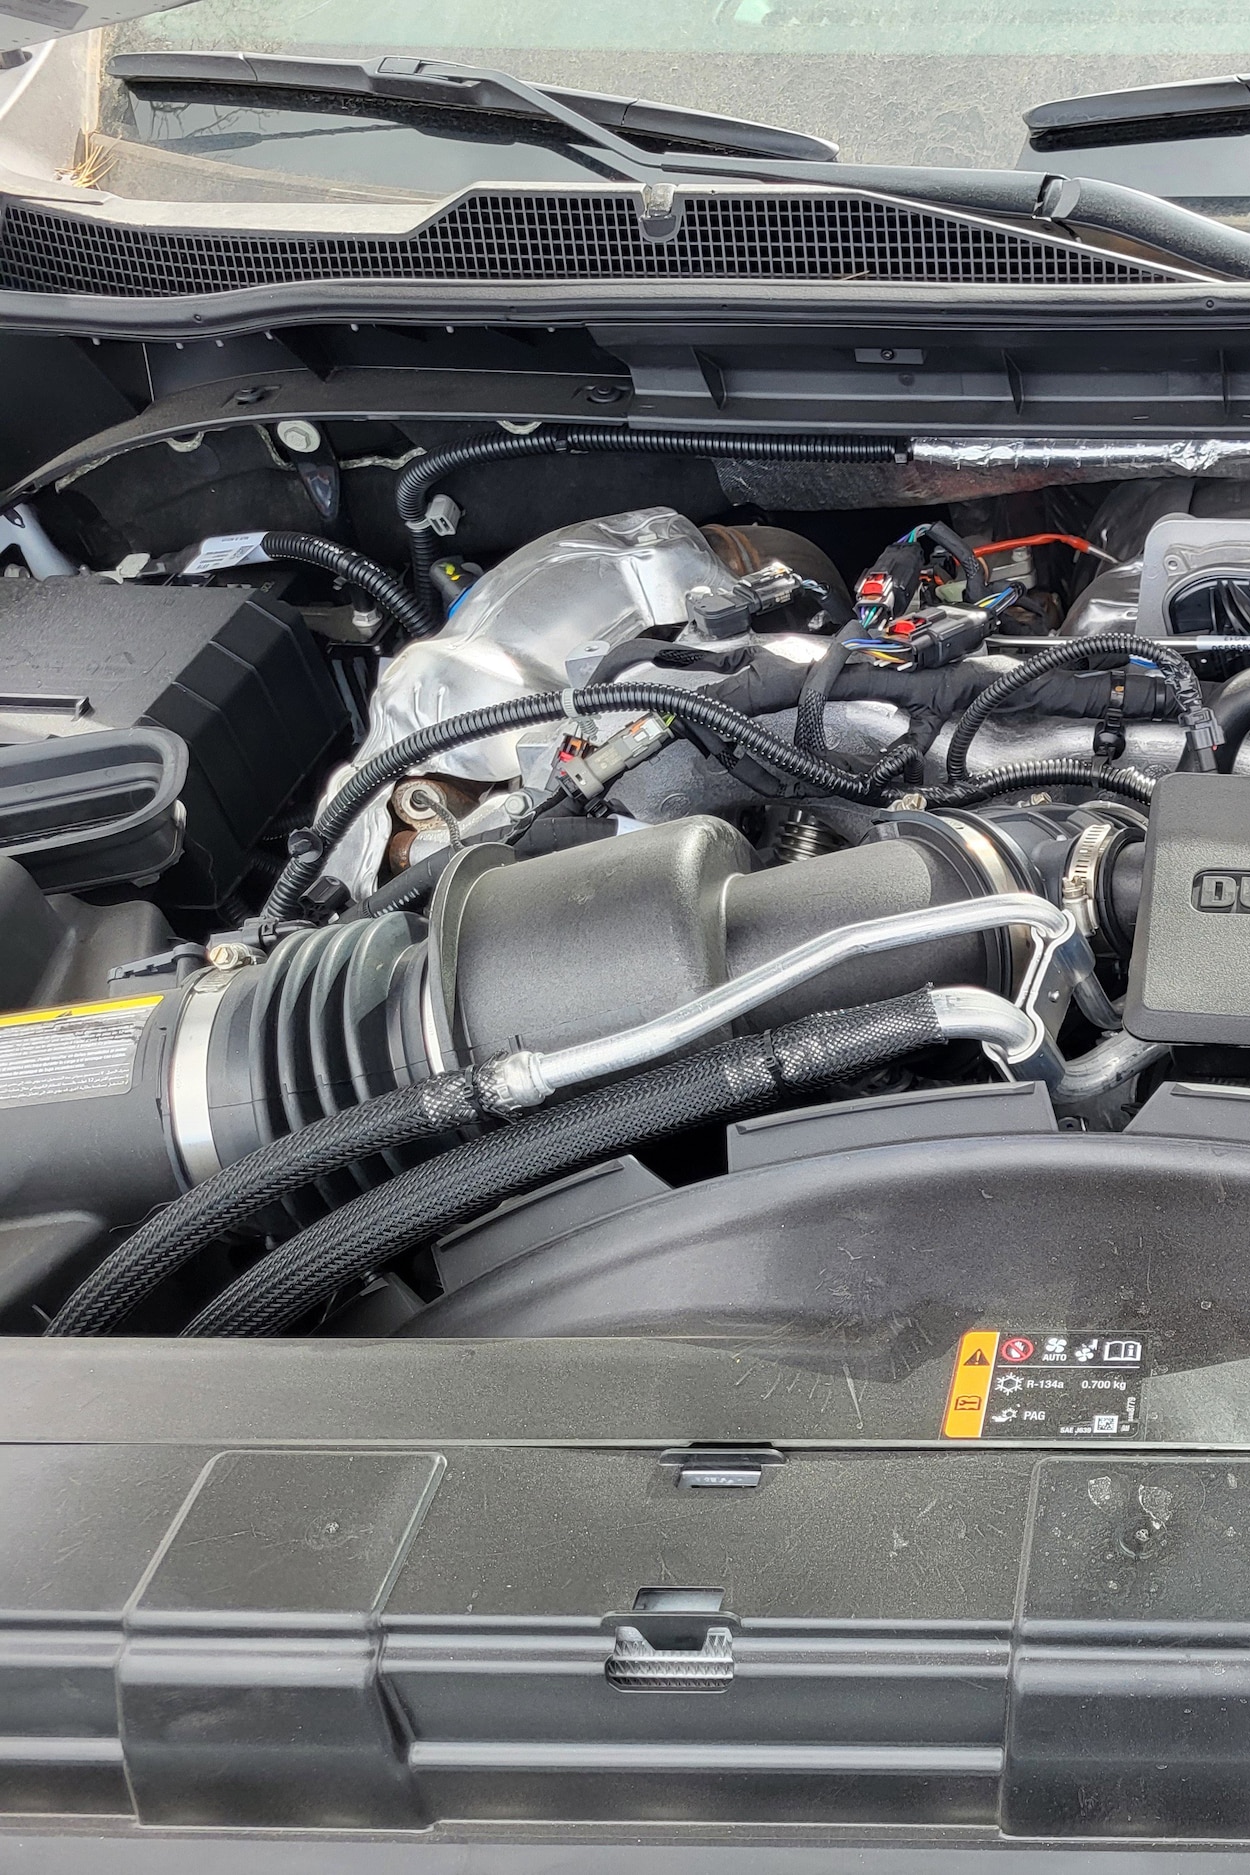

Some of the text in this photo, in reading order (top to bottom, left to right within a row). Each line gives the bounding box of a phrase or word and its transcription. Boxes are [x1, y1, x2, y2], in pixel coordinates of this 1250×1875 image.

[1042, 1353, 1067, 1362] AUTO
[1026, 1380, 1126, 1391] R-134a 0.700 kg
[1024, 1411, 1046, 1421] PAG
